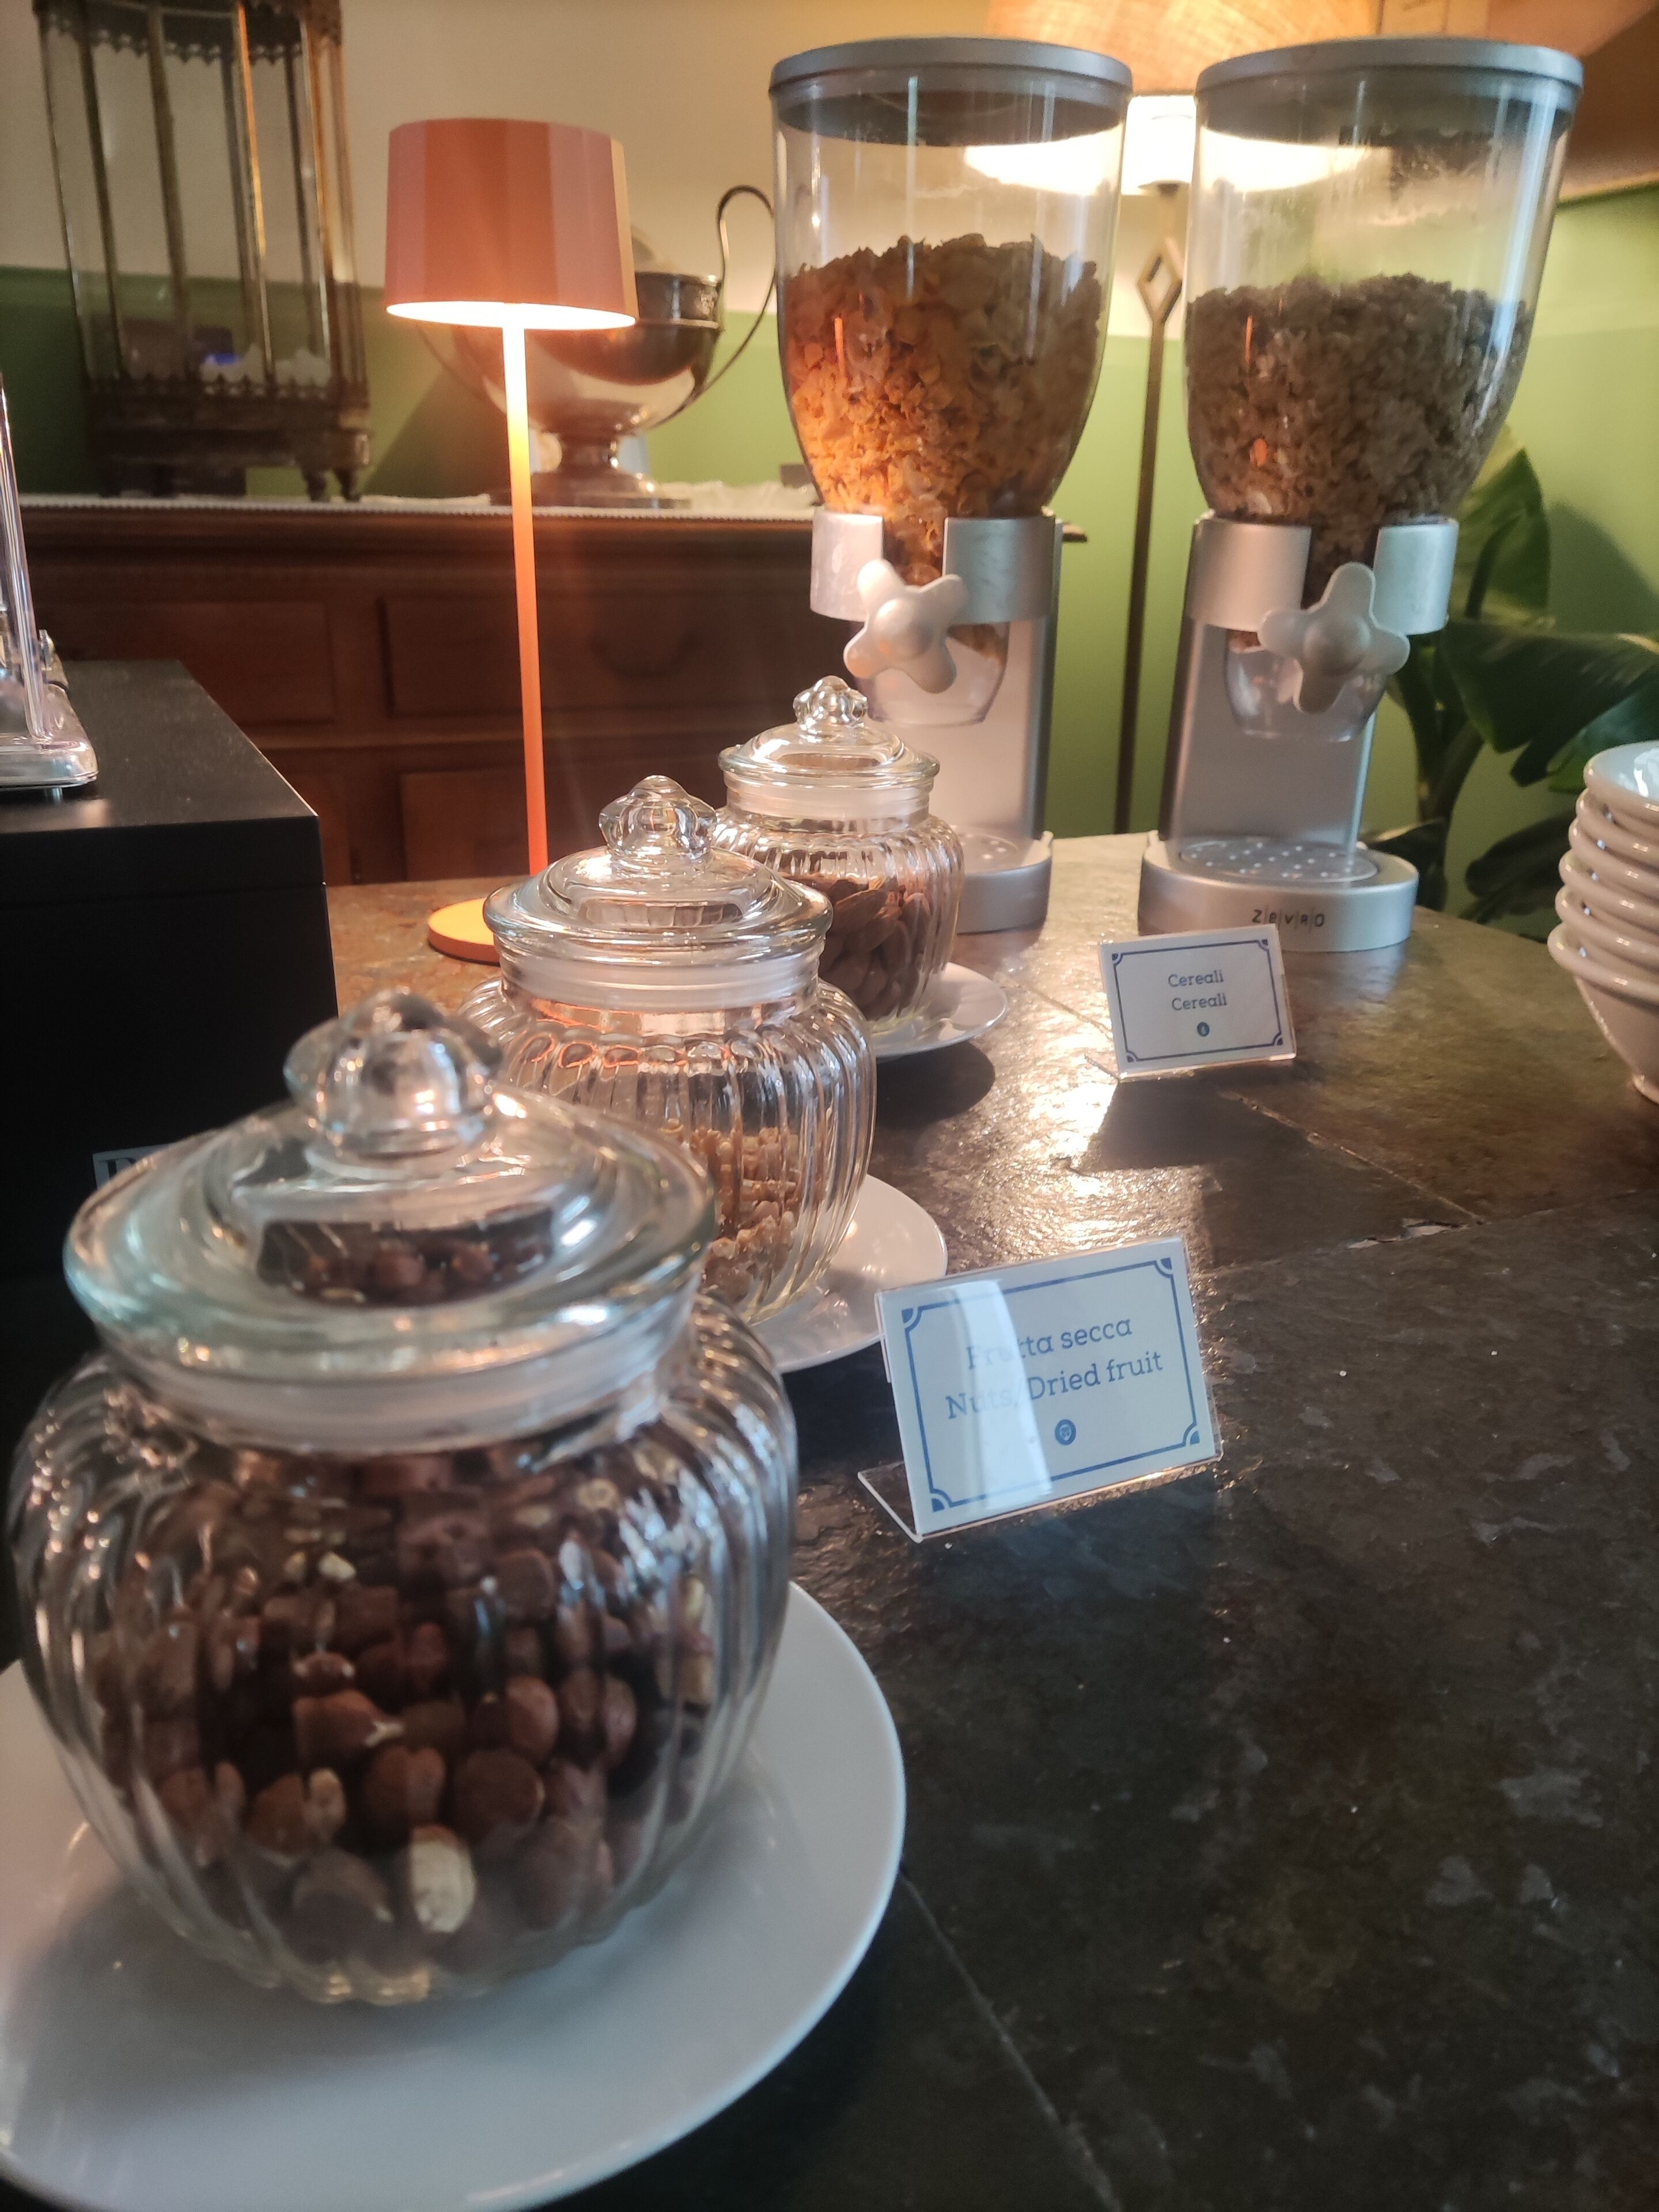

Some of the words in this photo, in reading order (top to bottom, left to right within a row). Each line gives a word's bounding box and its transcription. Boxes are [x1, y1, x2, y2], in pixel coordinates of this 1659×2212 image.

[1168, 969, 1224, 987] Cereali
[1060, 1318, 1132, 1349] secca
[1105, 1351, 1163, 1382] fruit
